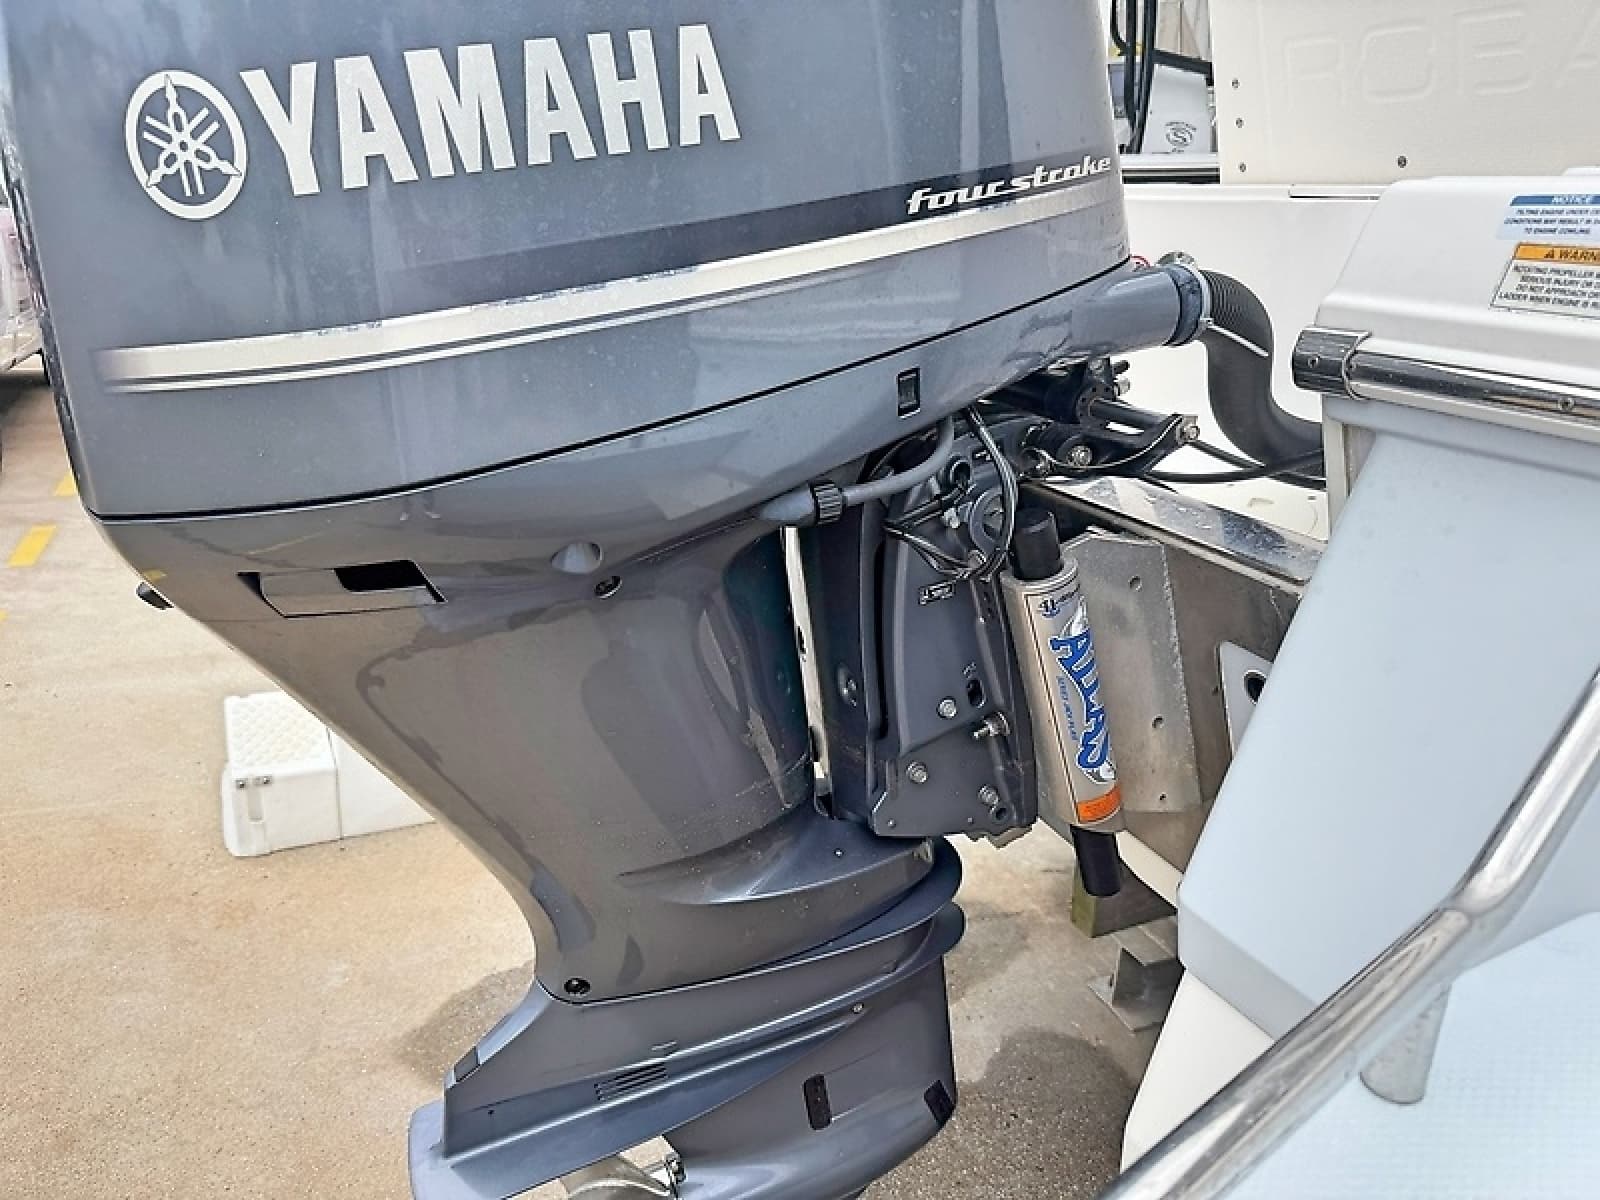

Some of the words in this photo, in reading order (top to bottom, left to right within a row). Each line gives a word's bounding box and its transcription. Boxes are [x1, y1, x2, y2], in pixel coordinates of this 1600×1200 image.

[239, 24, 741, 196] YAMAHA
[907, 181, 1005, 214] four
[1009, 155, 1111, 194] stroke
[1551, 194, 1593, 205] NOTICE
